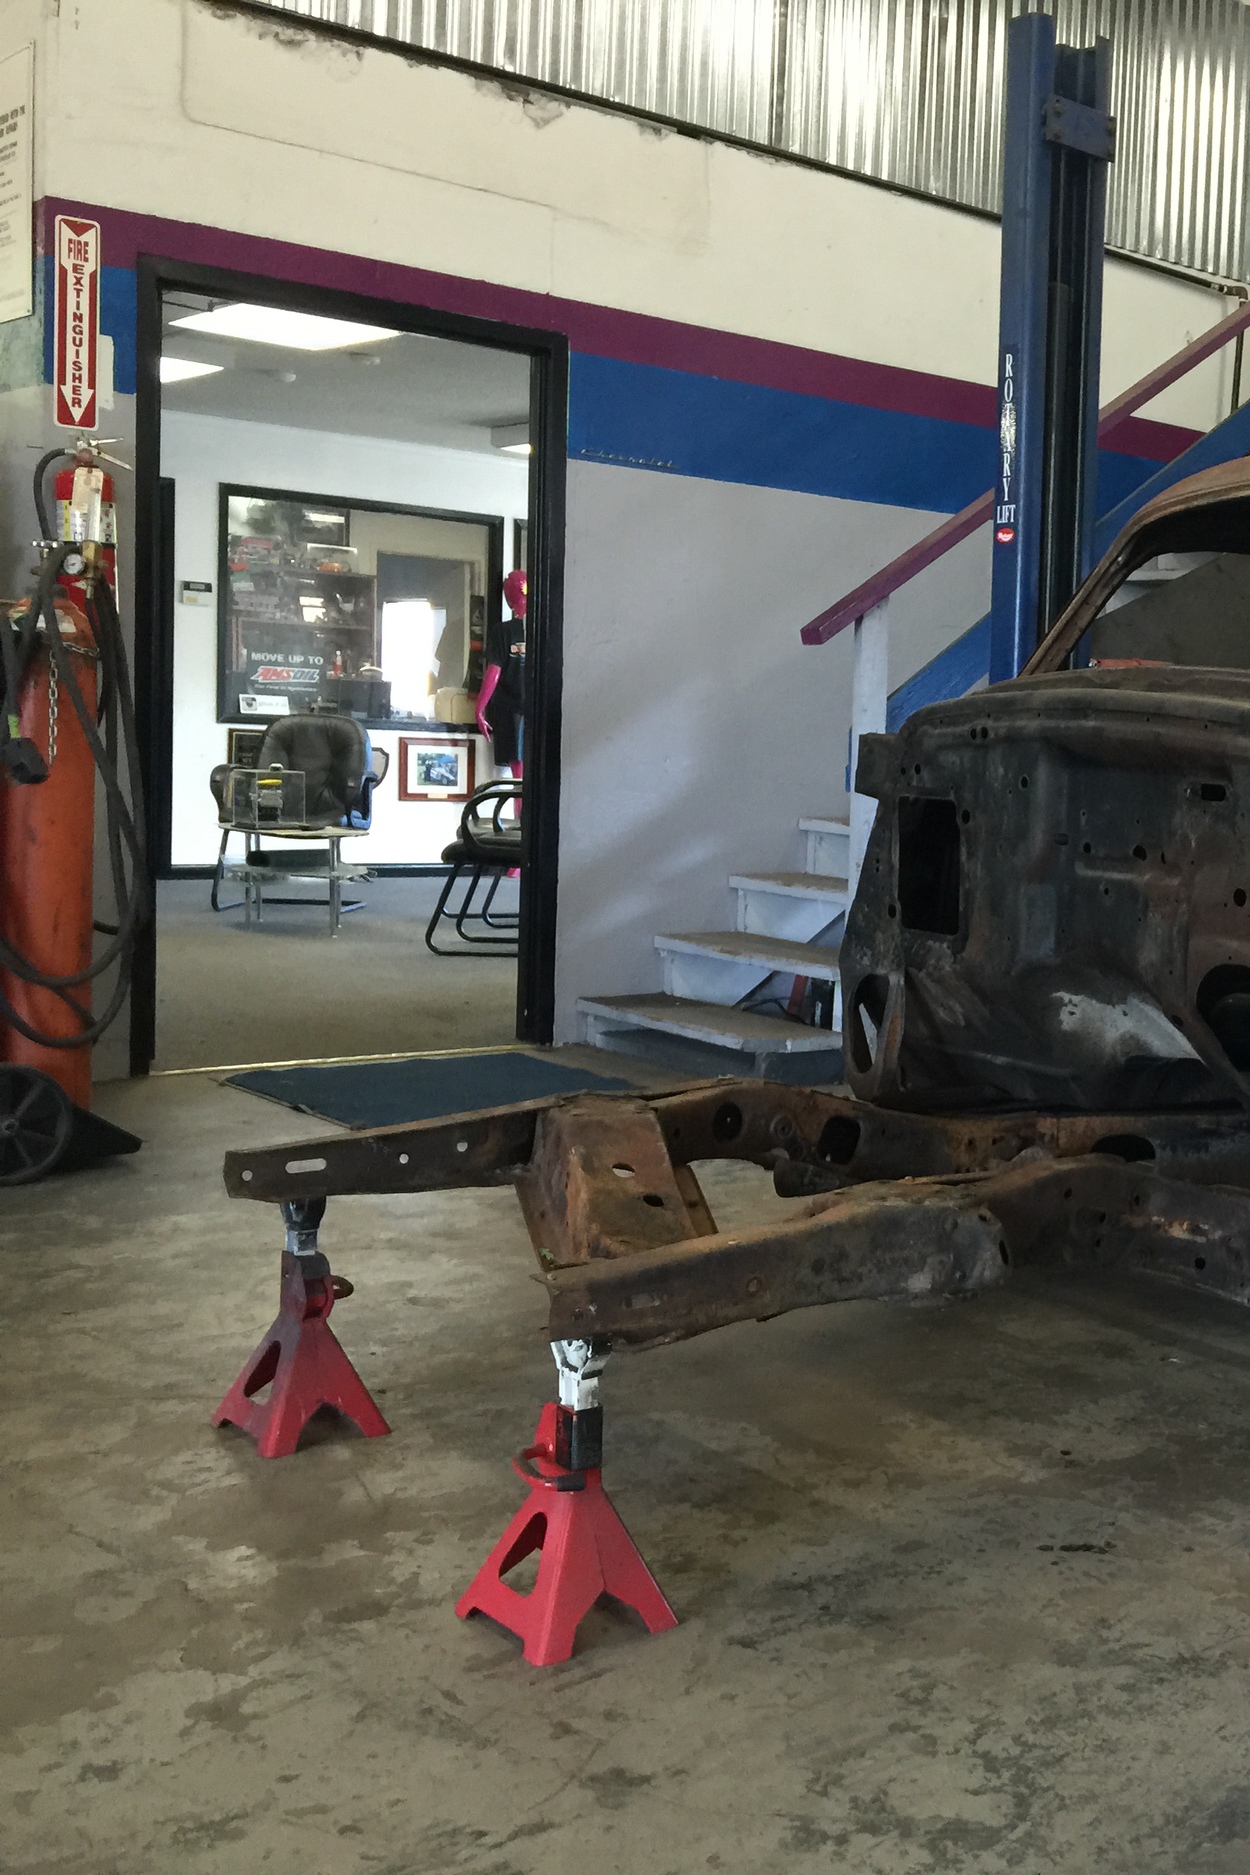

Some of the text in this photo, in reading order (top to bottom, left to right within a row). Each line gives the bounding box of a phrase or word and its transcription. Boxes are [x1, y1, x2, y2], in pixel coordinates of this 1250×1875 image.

[67, 237, 89, 263] FIRE
[71, 262, 85, 408] EXTINGUISHER
[996, 504, 1016, 524] LIFT
[251, 651, 324, 666] MOVE UP TO
[250, 665, 320, 683] AMSOIL
